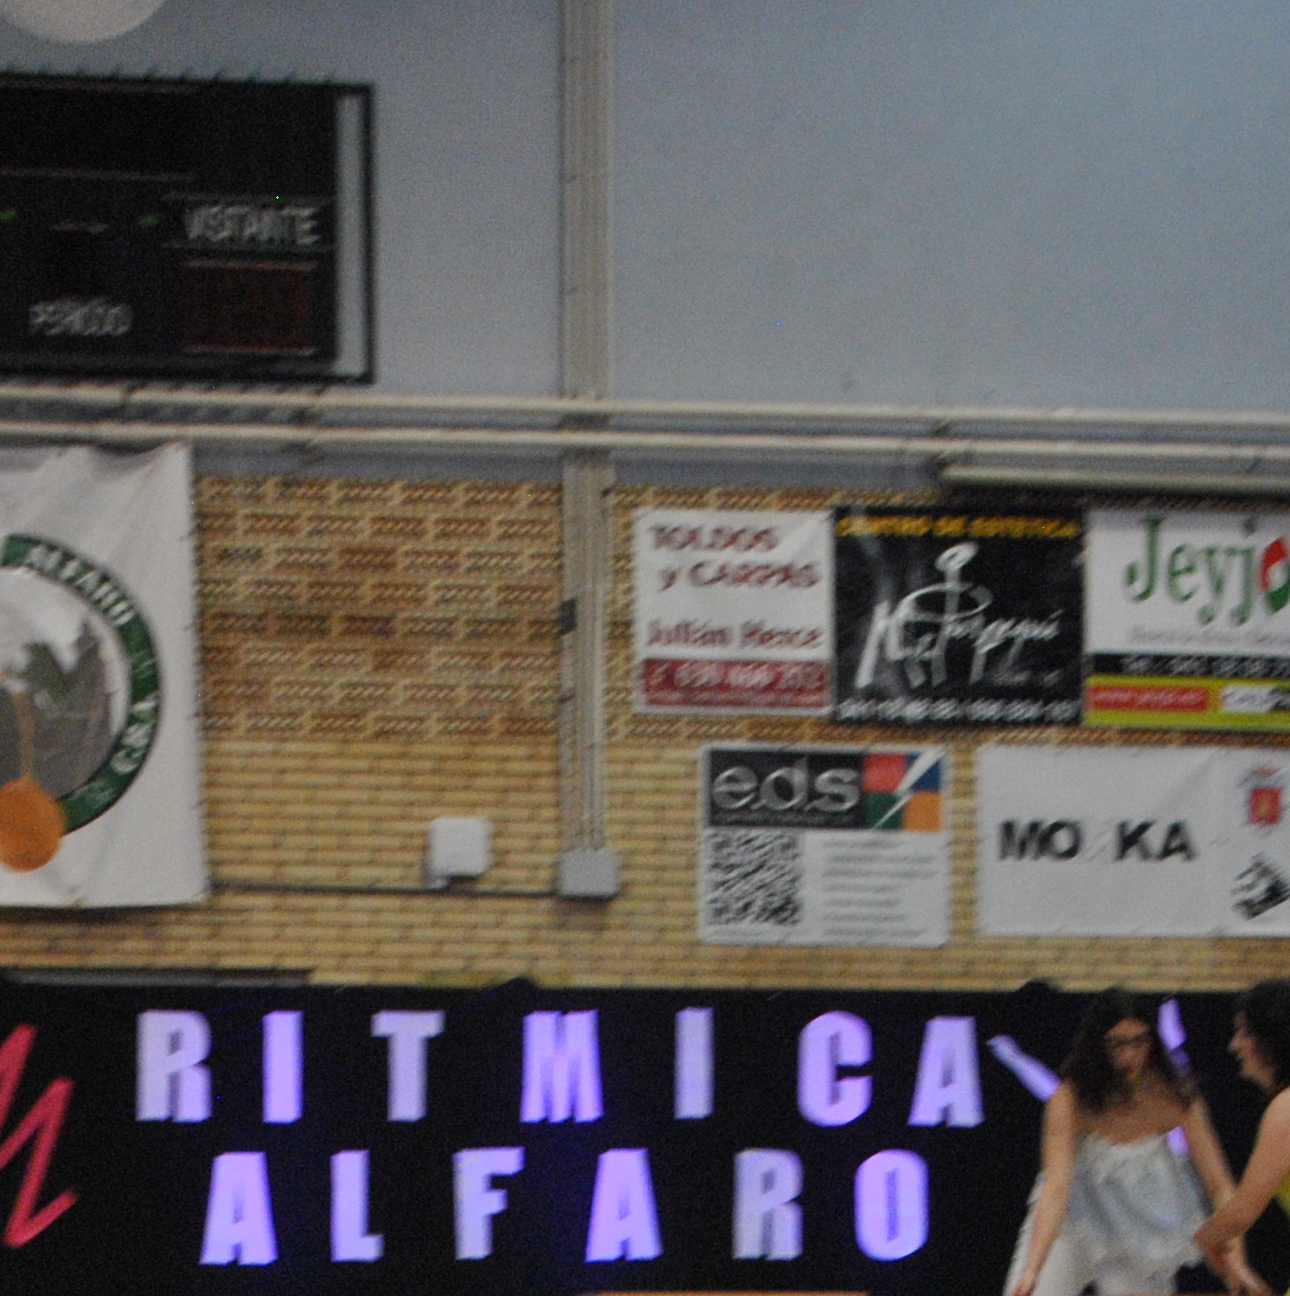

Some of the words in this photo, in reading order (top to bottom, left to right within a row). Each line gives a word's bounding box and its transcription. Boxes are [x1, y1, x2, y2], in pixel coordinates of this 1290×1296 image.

[648, 523, 780, 553] TOLDOS
[687, 560, 822, 589] CARPAS
[134, 1005, 985, 1128] RITMICA
[198, 1146, 930, 1267] ALFARO
